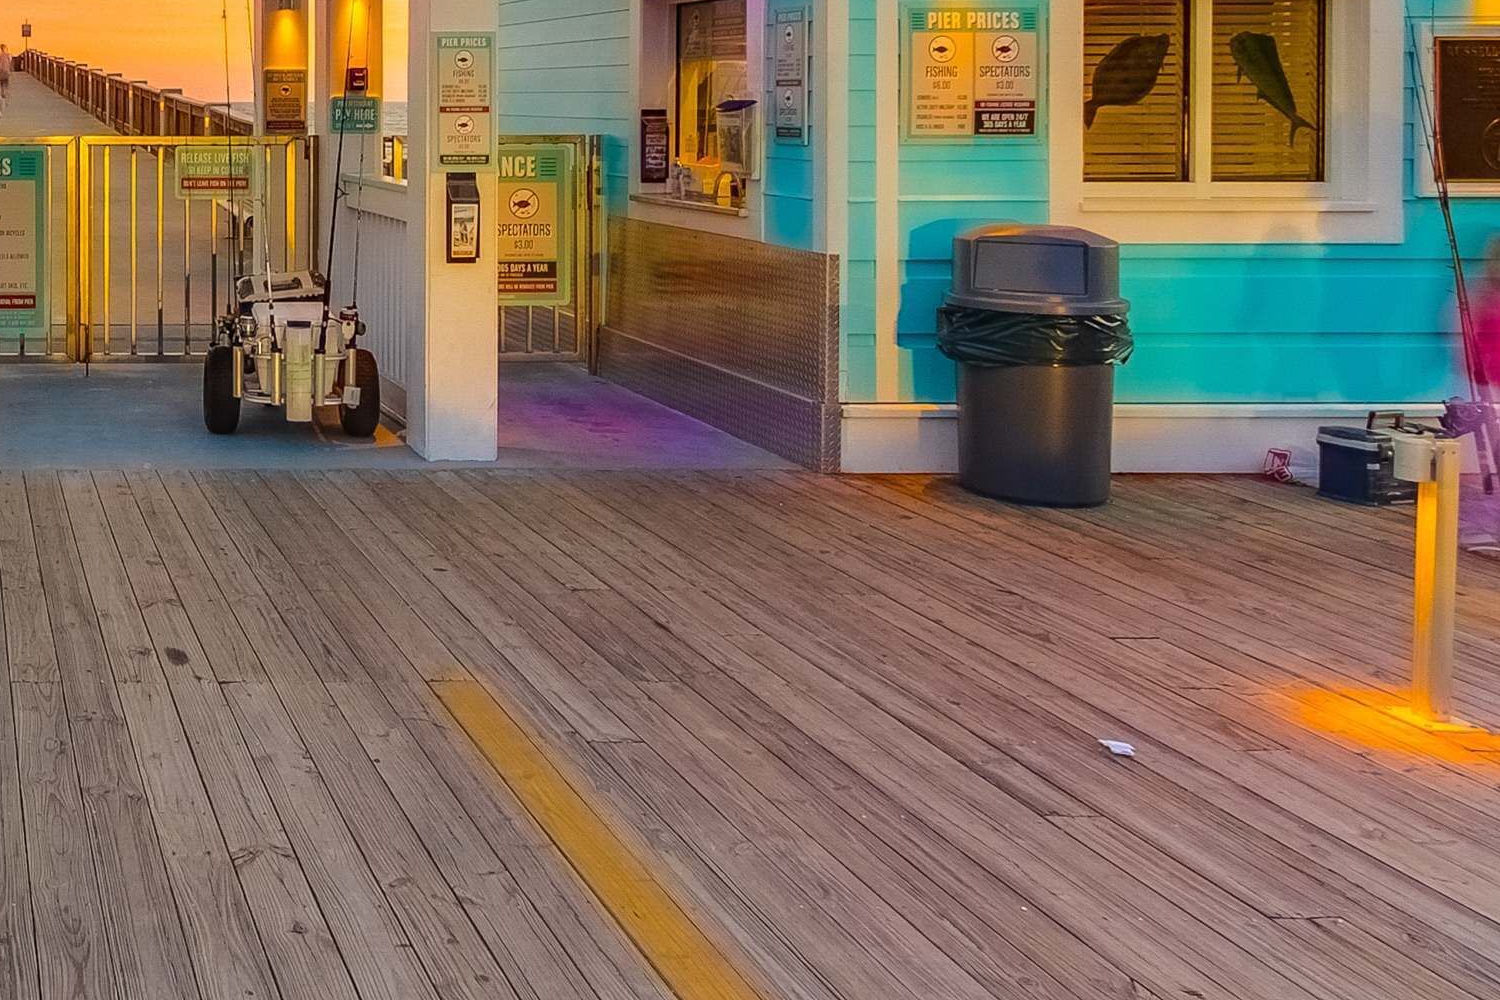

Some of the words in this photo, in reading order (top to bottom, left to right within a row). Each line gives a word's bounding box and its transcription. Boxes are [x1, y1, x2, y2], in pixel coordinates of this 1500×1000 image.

[928, 12, 961, 29] PIER
[967, 12, 1020, 29] PRICES
[442, 38, 458, 46] PIER
[461, 38, 486, 46] PRICES
[926, 66, 958, 78] FISHING
[980, 66, 1030, 78] SPECTATORS
[354, 108, 375, 120] HERE
[182, 153, 212, 163] RELEASE
[215, 153, 230, 163] LIVE
[232, 153, 249, 163] FISH
[221, 166, 244, 174] COLER
[511, 264, 526, 272] DAYS
[527, 264, 532, 272] A
[533, 264, 549, 272] YEAR
